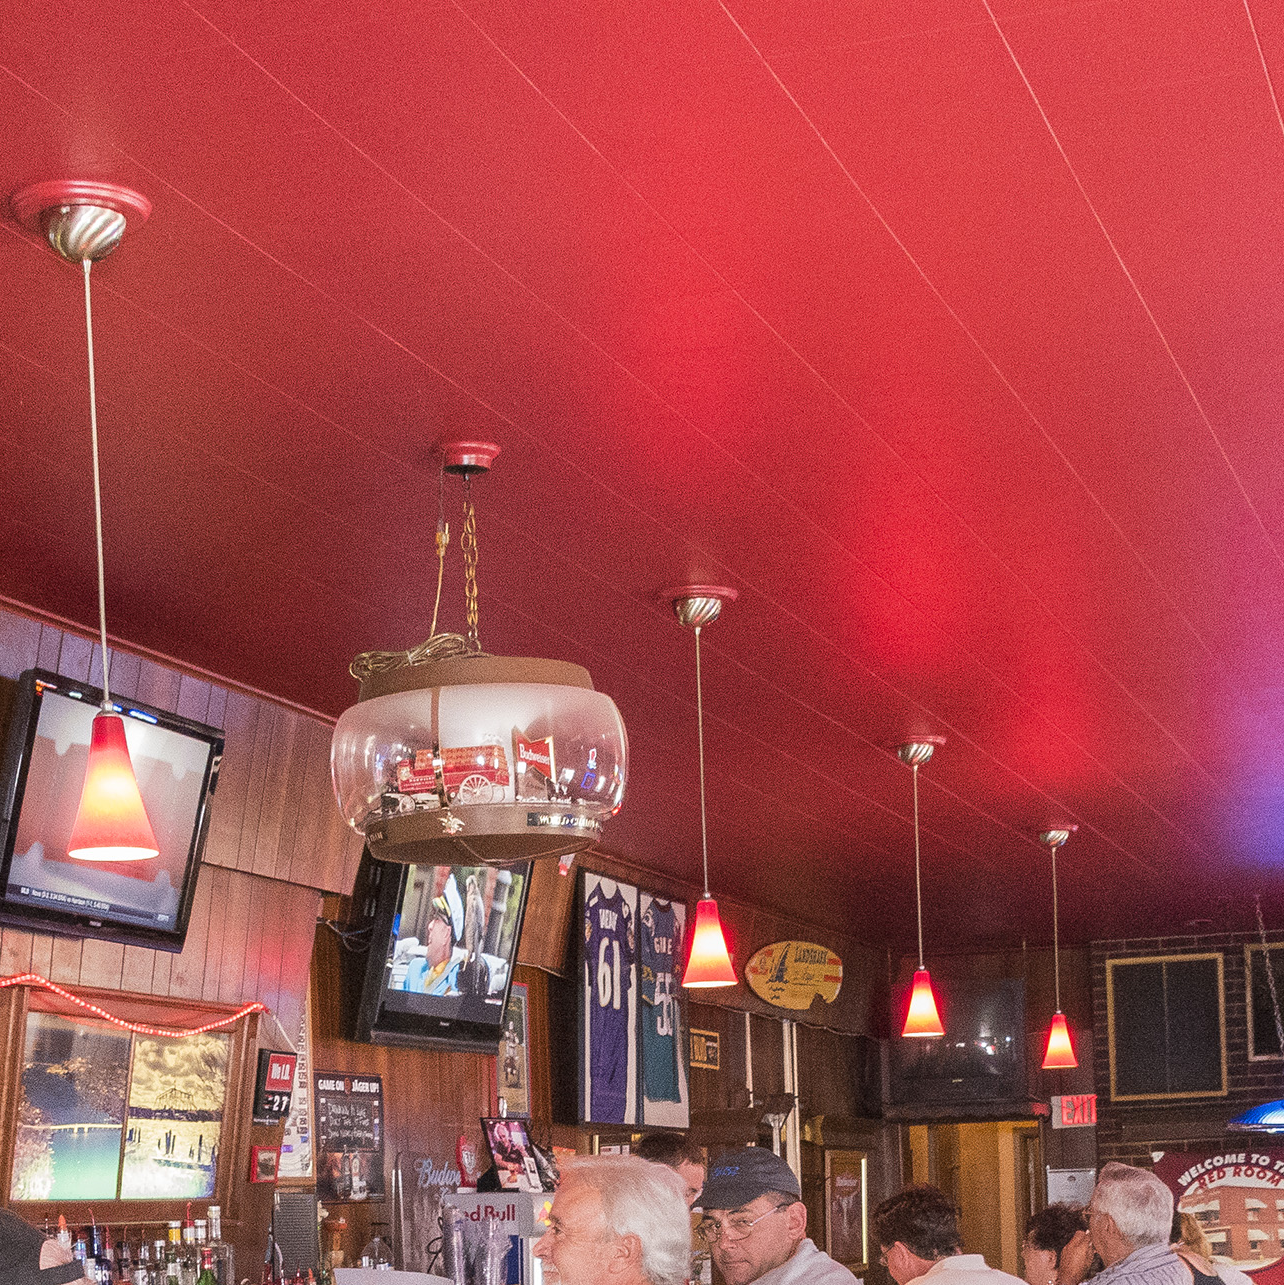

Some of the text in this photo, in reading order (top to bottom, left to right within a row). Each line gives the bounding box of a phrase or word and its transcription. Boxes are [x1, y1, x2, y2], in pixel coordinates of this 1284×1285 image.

[518, 742, 551, 765] Budweiser
[597, 937, 621, 1011] 61
[318, 1079, 380, 1093] GAME ON JÄGER UP!
[1061, 1094, 1097, 1125] EXIT
[1176, 1152, 1247, 1188] WELCOME
[1250, 1154, 1272, 1167] TO
[1198, 1165, 1283, 1191] RED ROOM
[484, 1204, 516, 1222] Bull
